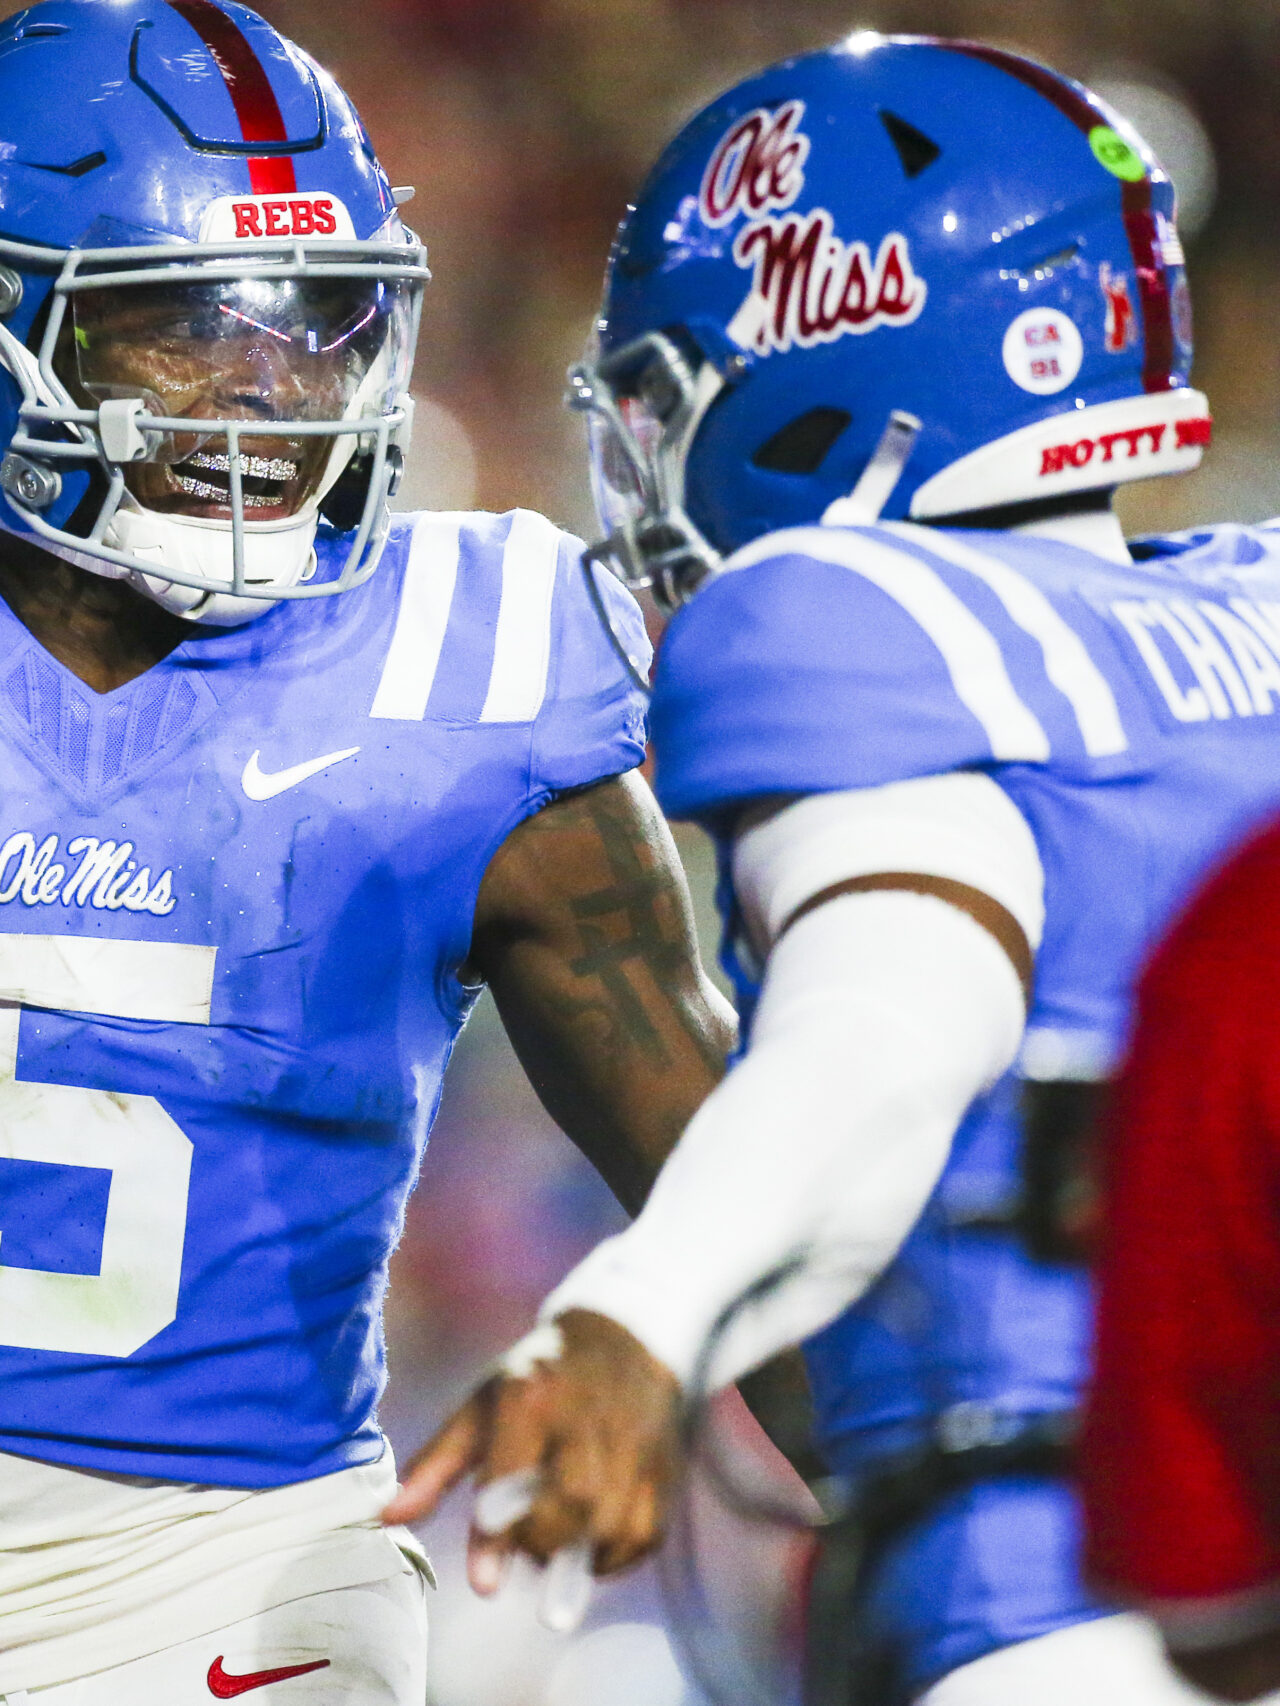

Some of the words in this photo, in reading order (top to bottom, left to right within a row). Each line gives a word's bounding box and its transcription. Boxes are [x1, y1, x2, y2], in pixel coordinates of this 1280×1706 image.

[699, 99, 811, 228] Ole
[231, 199, 337, 238] REBS
[732, 207, 927, 357] Miss
[61, 835, 179, 917] Miss
